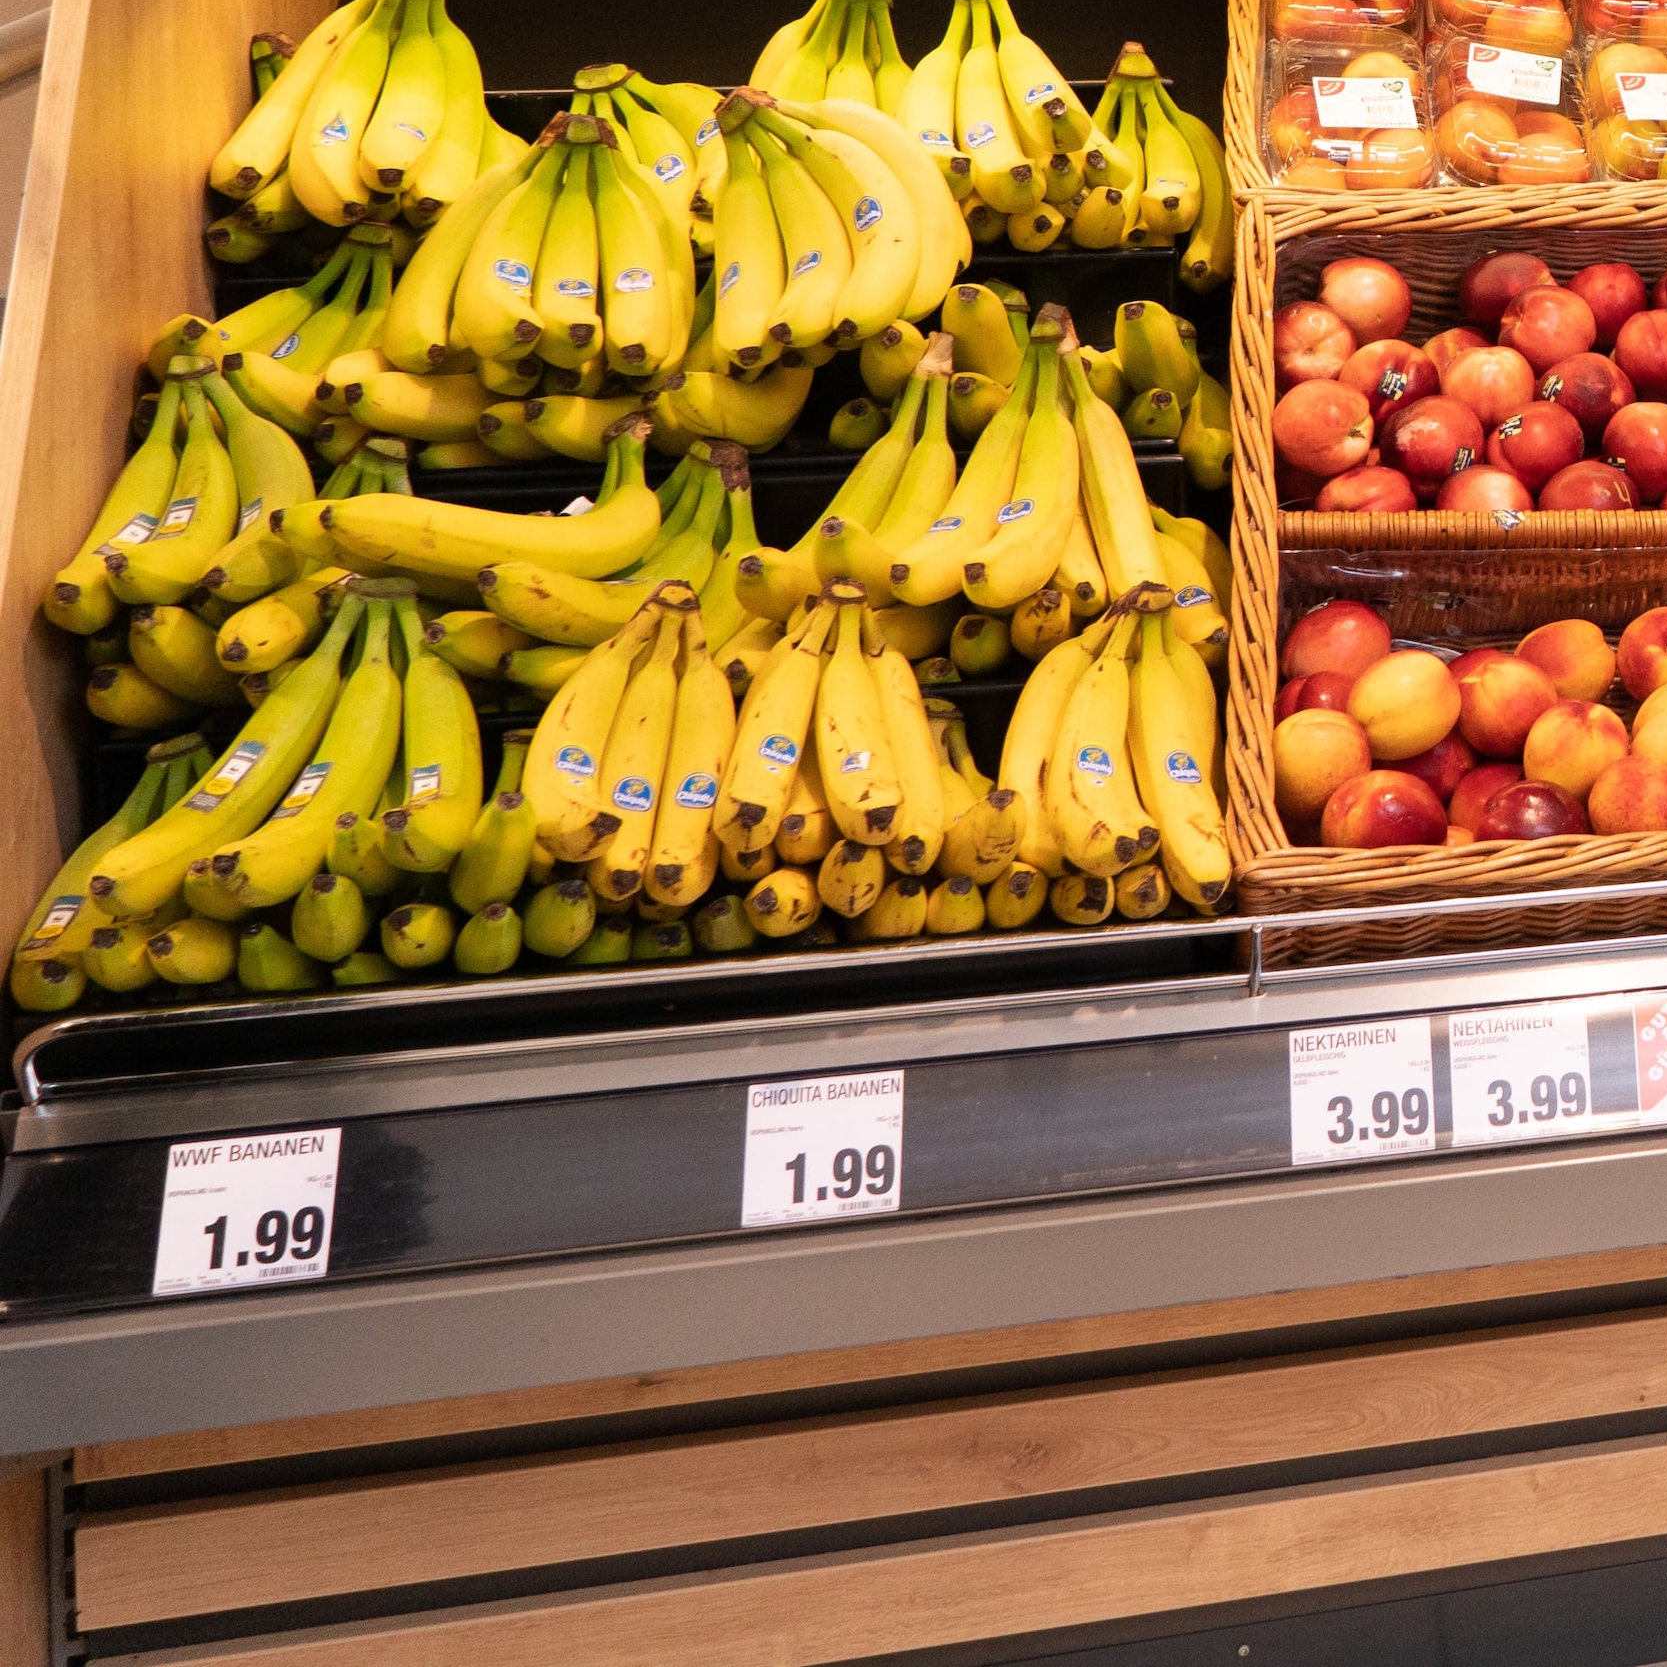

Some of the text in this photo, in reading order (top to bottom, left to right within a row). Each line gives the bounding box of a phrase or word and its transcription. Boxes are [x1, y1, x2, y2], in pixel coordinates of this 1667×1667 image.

[1293, 1027, 1396, 1052] NEKTARINEN
[1453, 1015, 1554, 1038] NEKTARINEN
[752, 1077, 901, 1109] CHIQUITA BANANEN
[1487, 1072, 1587, 1127] 3.99
[1327, 1087, 1430, 1144] 3.99
[172, 1135, 326, 1168] WWF BANANEN
[785, 1144, 896, 1204] 1.99
[204, 1205, 326, 1270] 1.99
